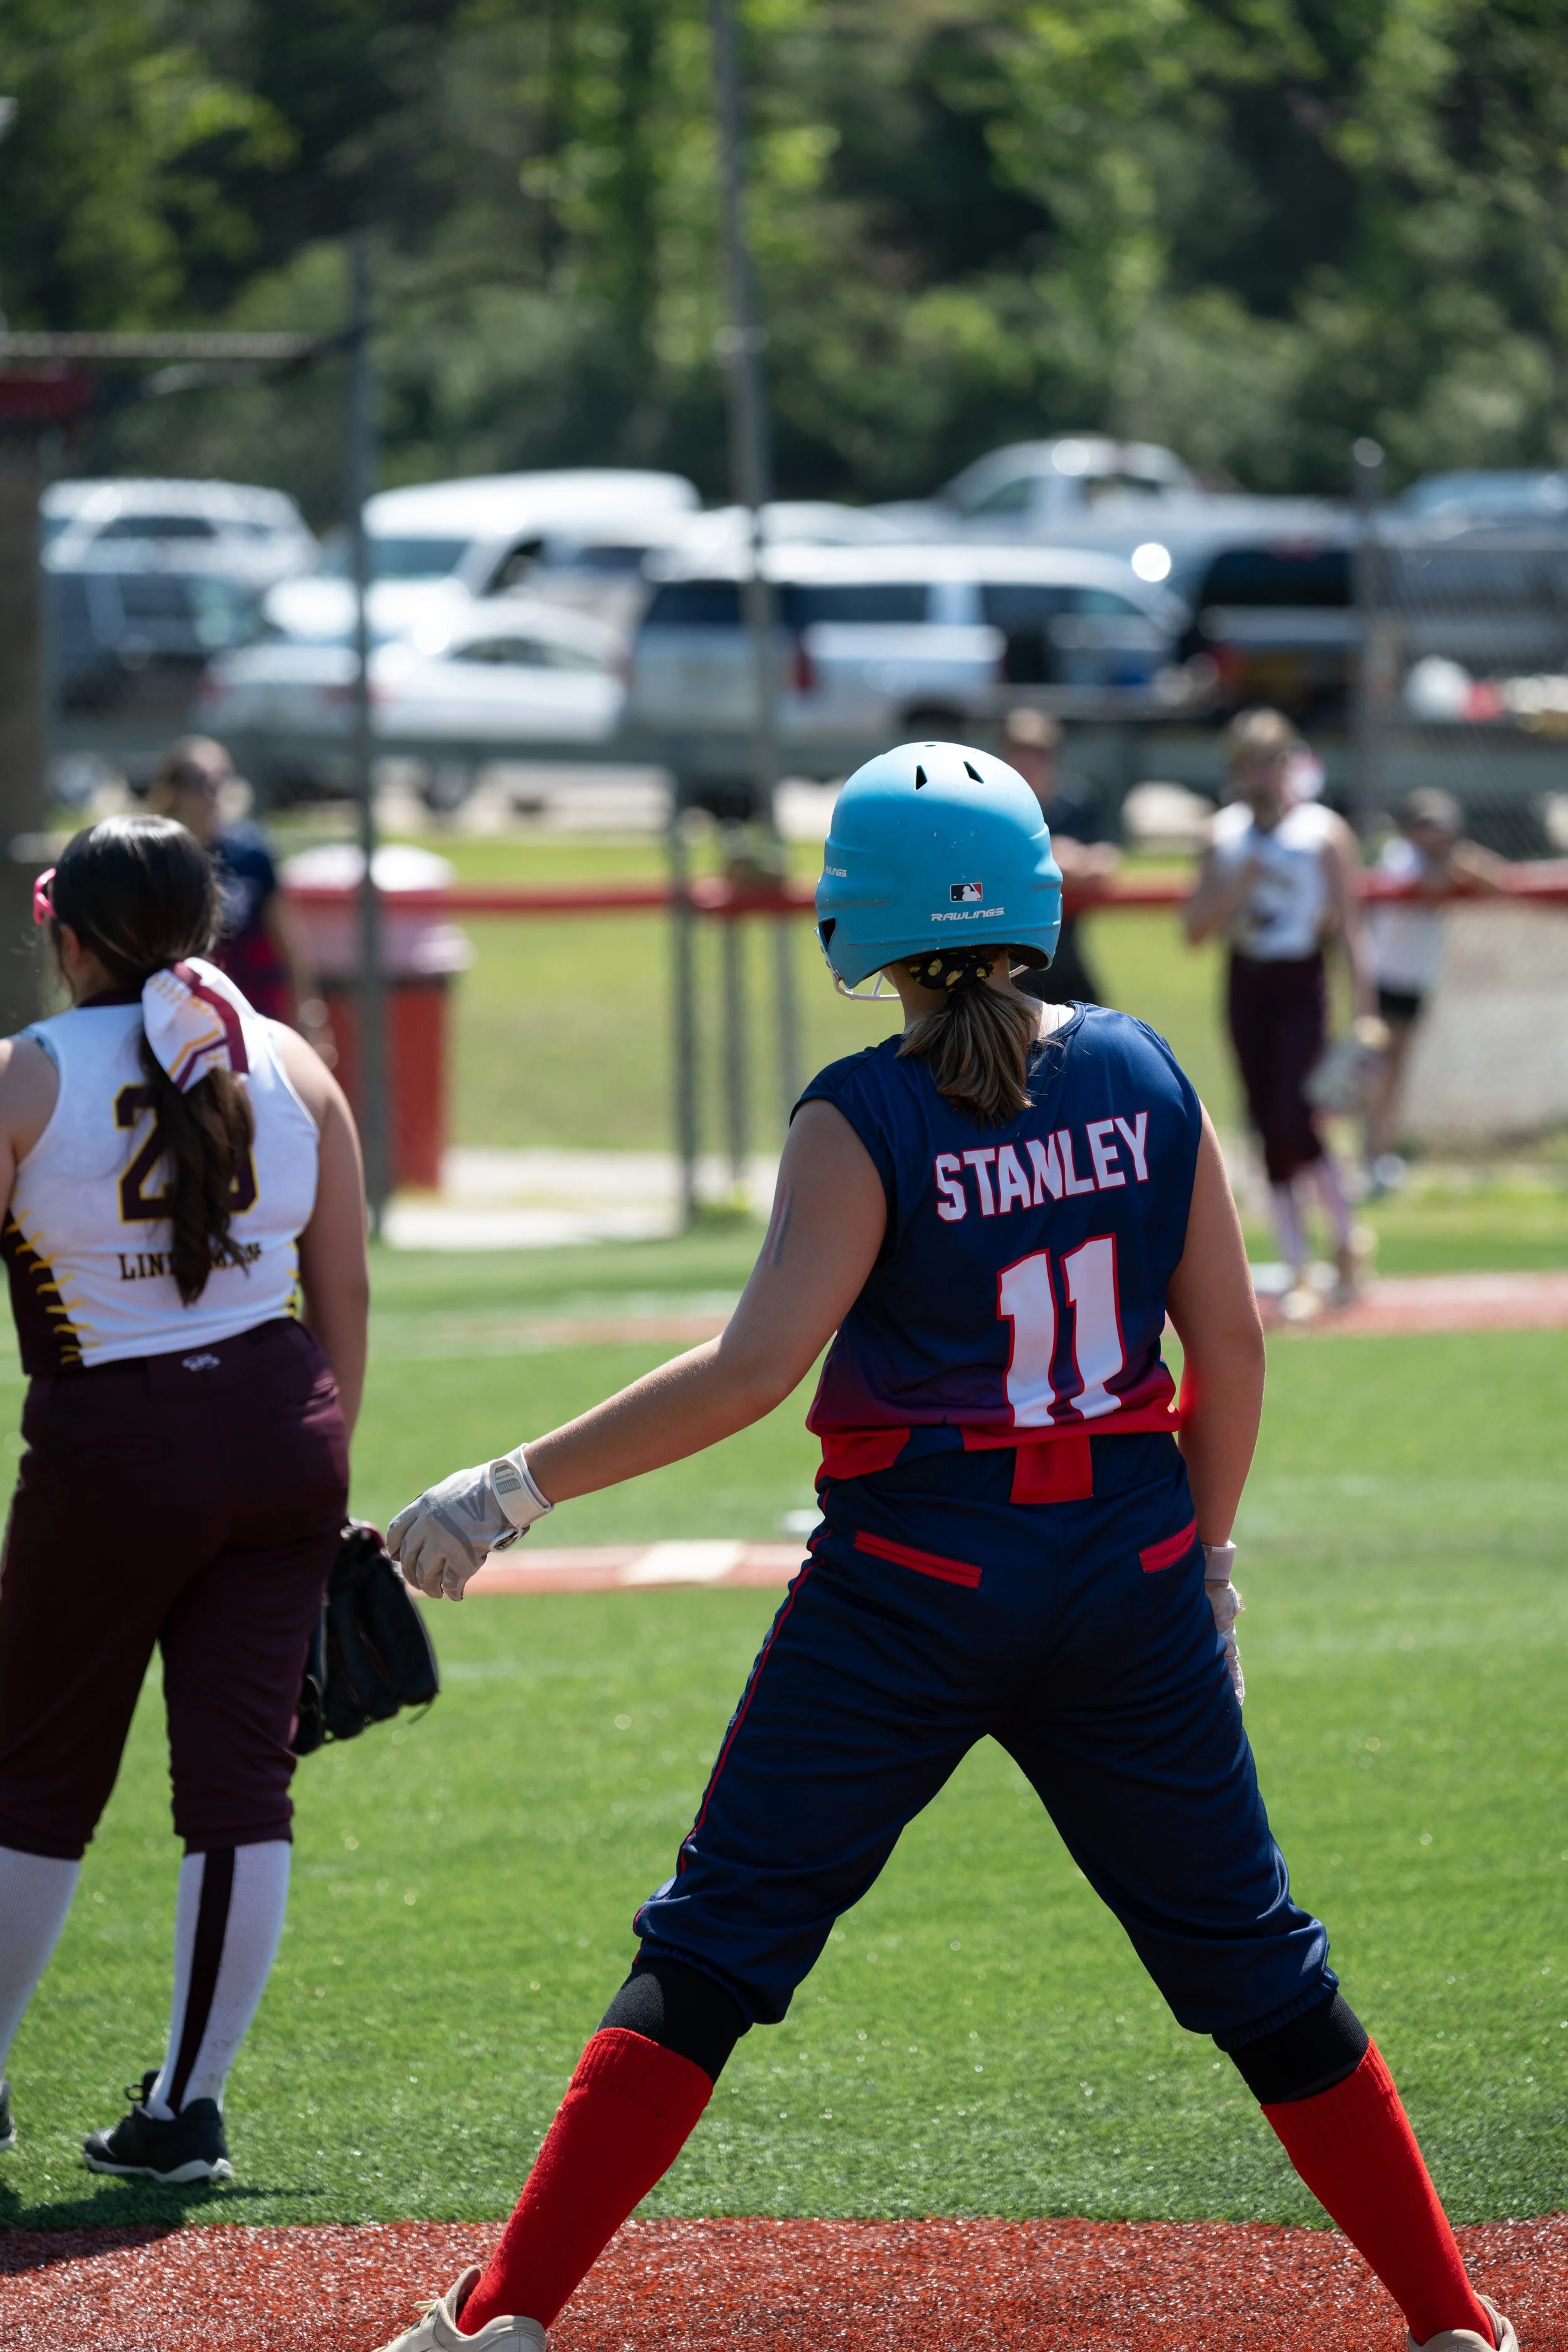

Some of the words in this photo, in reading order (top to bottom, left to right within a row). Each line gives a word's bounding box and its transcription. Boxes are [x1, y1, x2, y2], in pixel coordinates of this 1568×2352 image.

[931, 907, 1004, 921] RAWLINGS
[935, 1110, 1149, 1222] STANLEY
[997, 1232, 1127, 1428] 11
